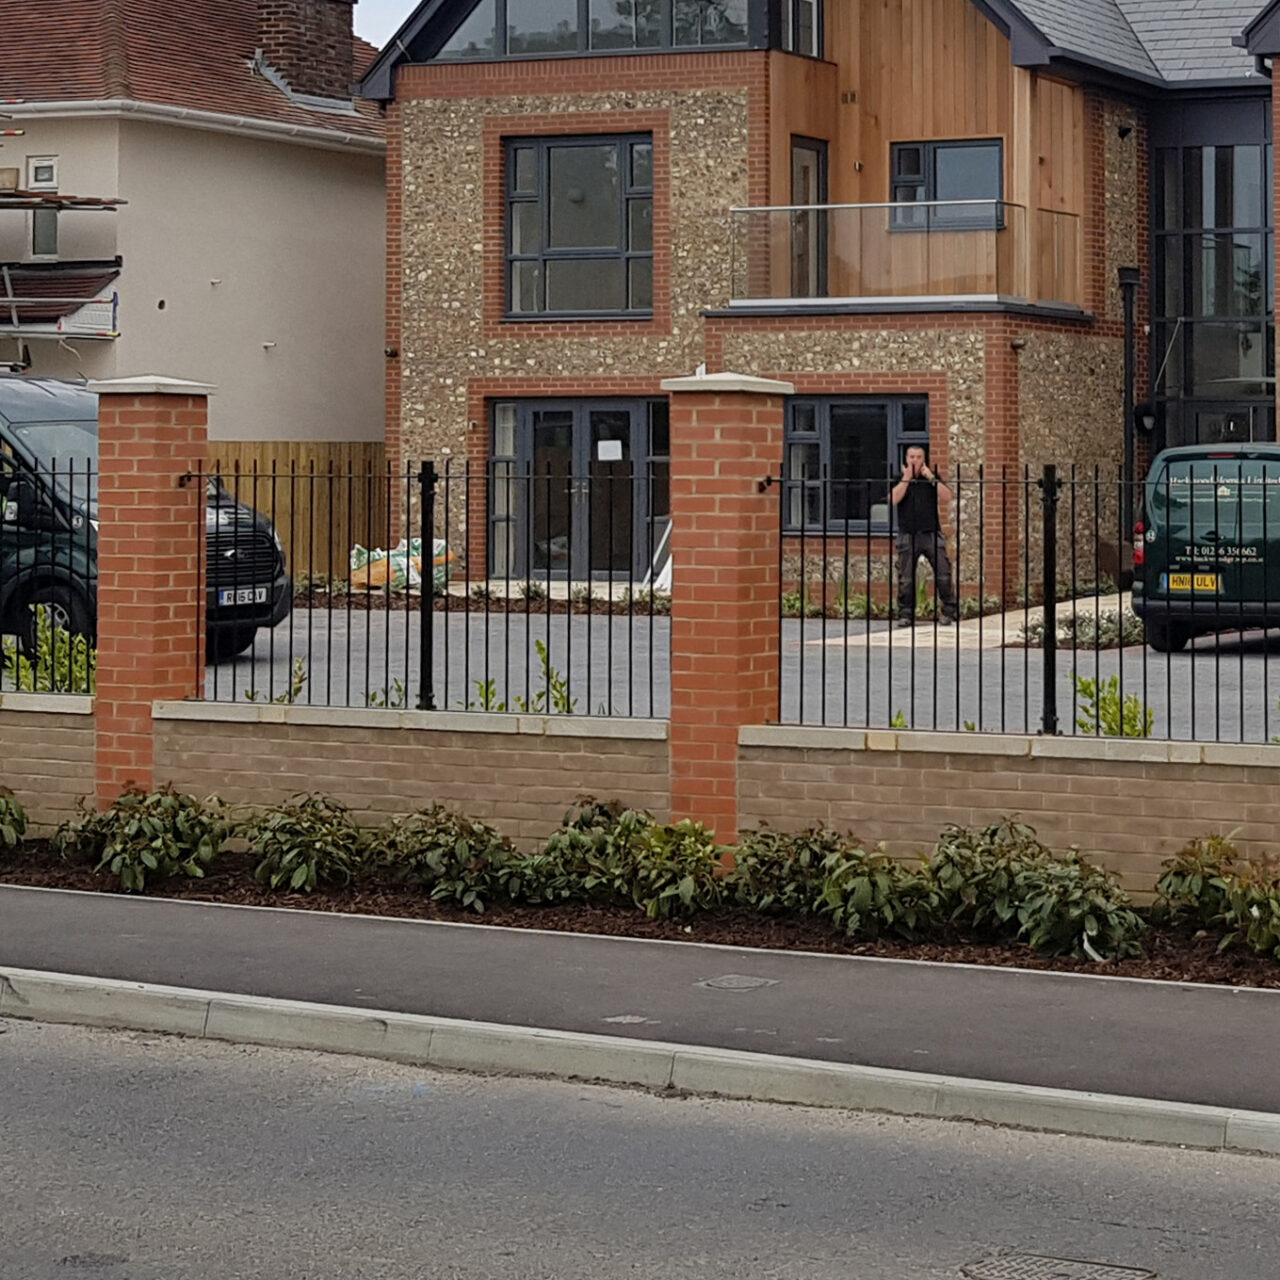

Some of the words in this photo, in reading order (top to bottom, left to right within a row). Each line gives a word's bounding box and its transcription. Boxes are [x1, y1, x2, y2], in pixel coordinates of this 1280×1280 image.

[1184, 546, 1199, 556] Tl:
[1200, 546, 1225, 556] 0126
[226, 592, 246, 603] R15
